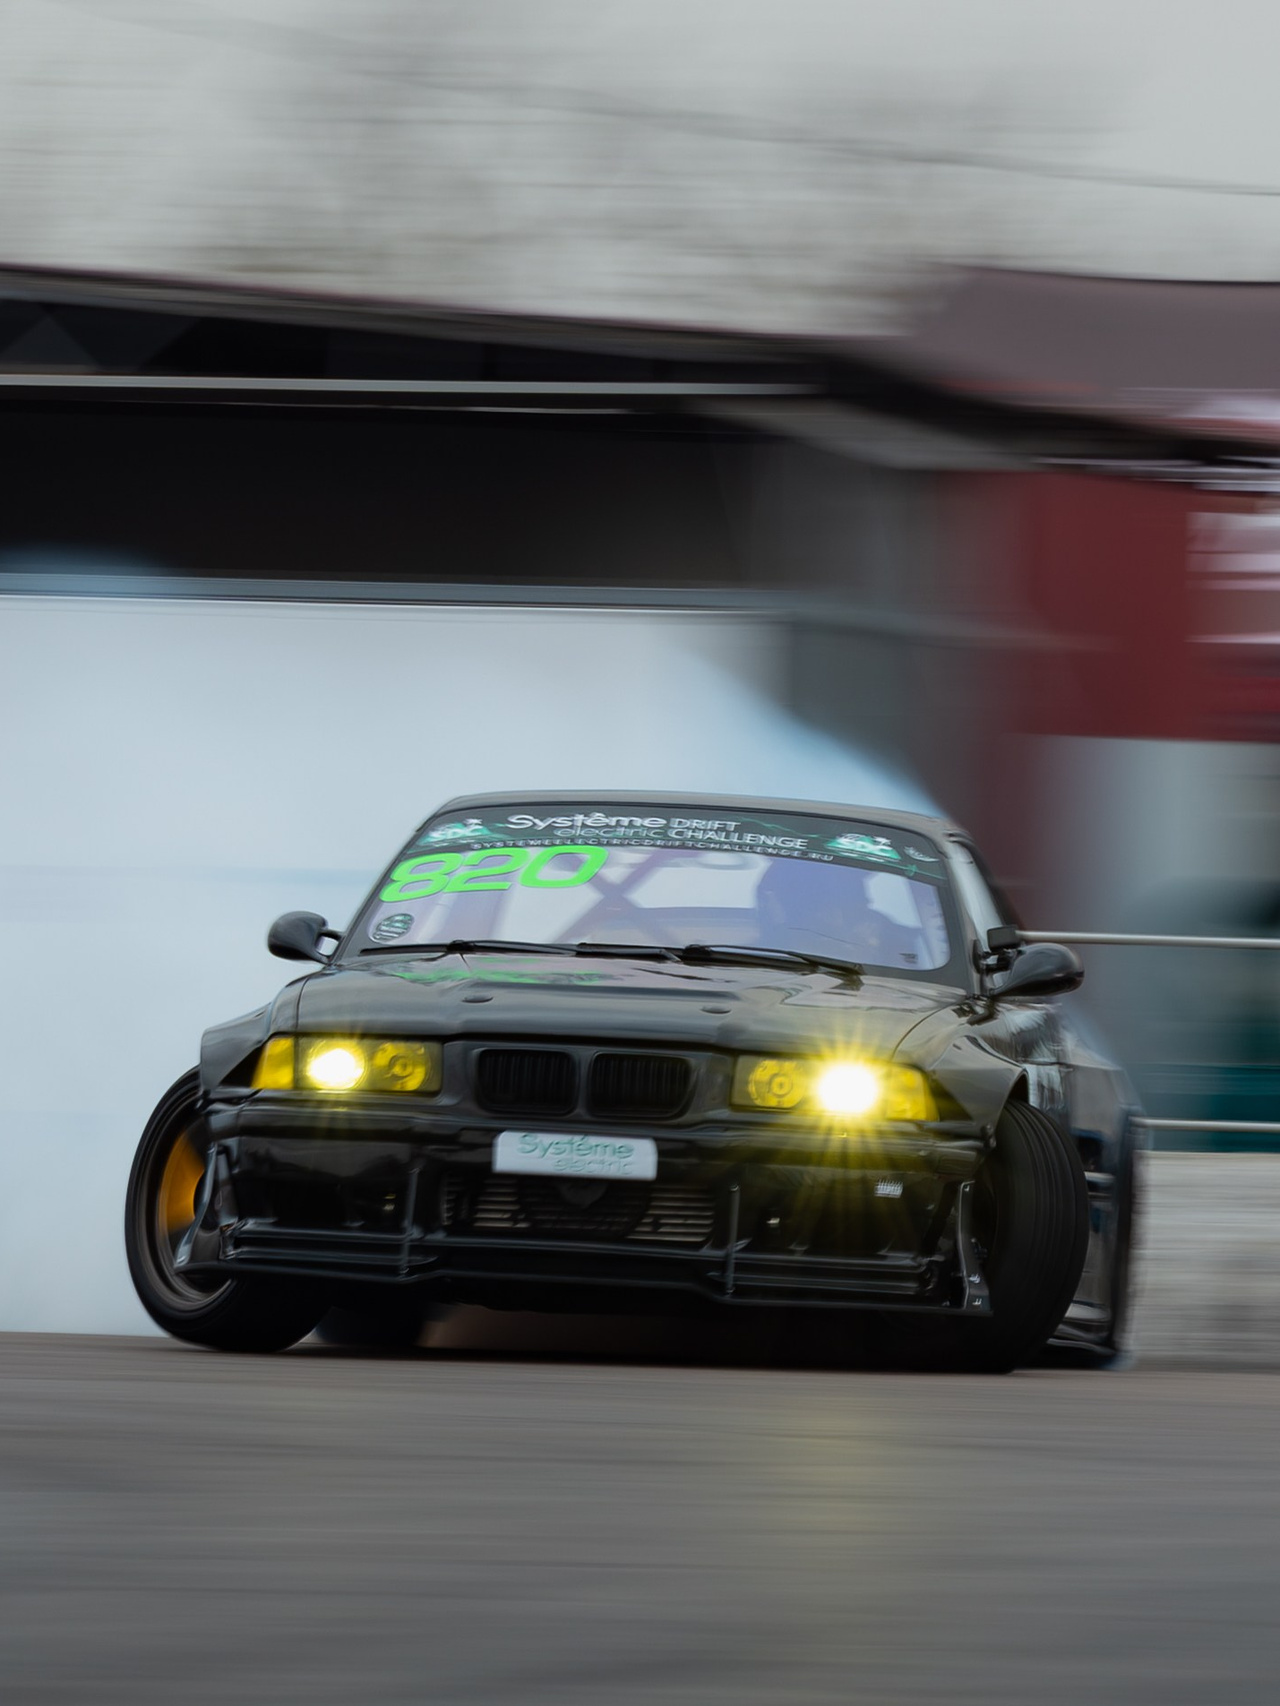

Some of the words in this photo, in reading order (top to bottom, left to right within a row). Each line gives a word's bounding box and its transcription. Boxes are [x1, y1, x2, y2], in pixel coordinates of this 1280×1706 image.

[553, 825, 665, 838] electric
[667, 829, 808, 849] CHALLENGE
[670, 818, 740, 832] DRIFT
[380, 845, 609, 903] 820
